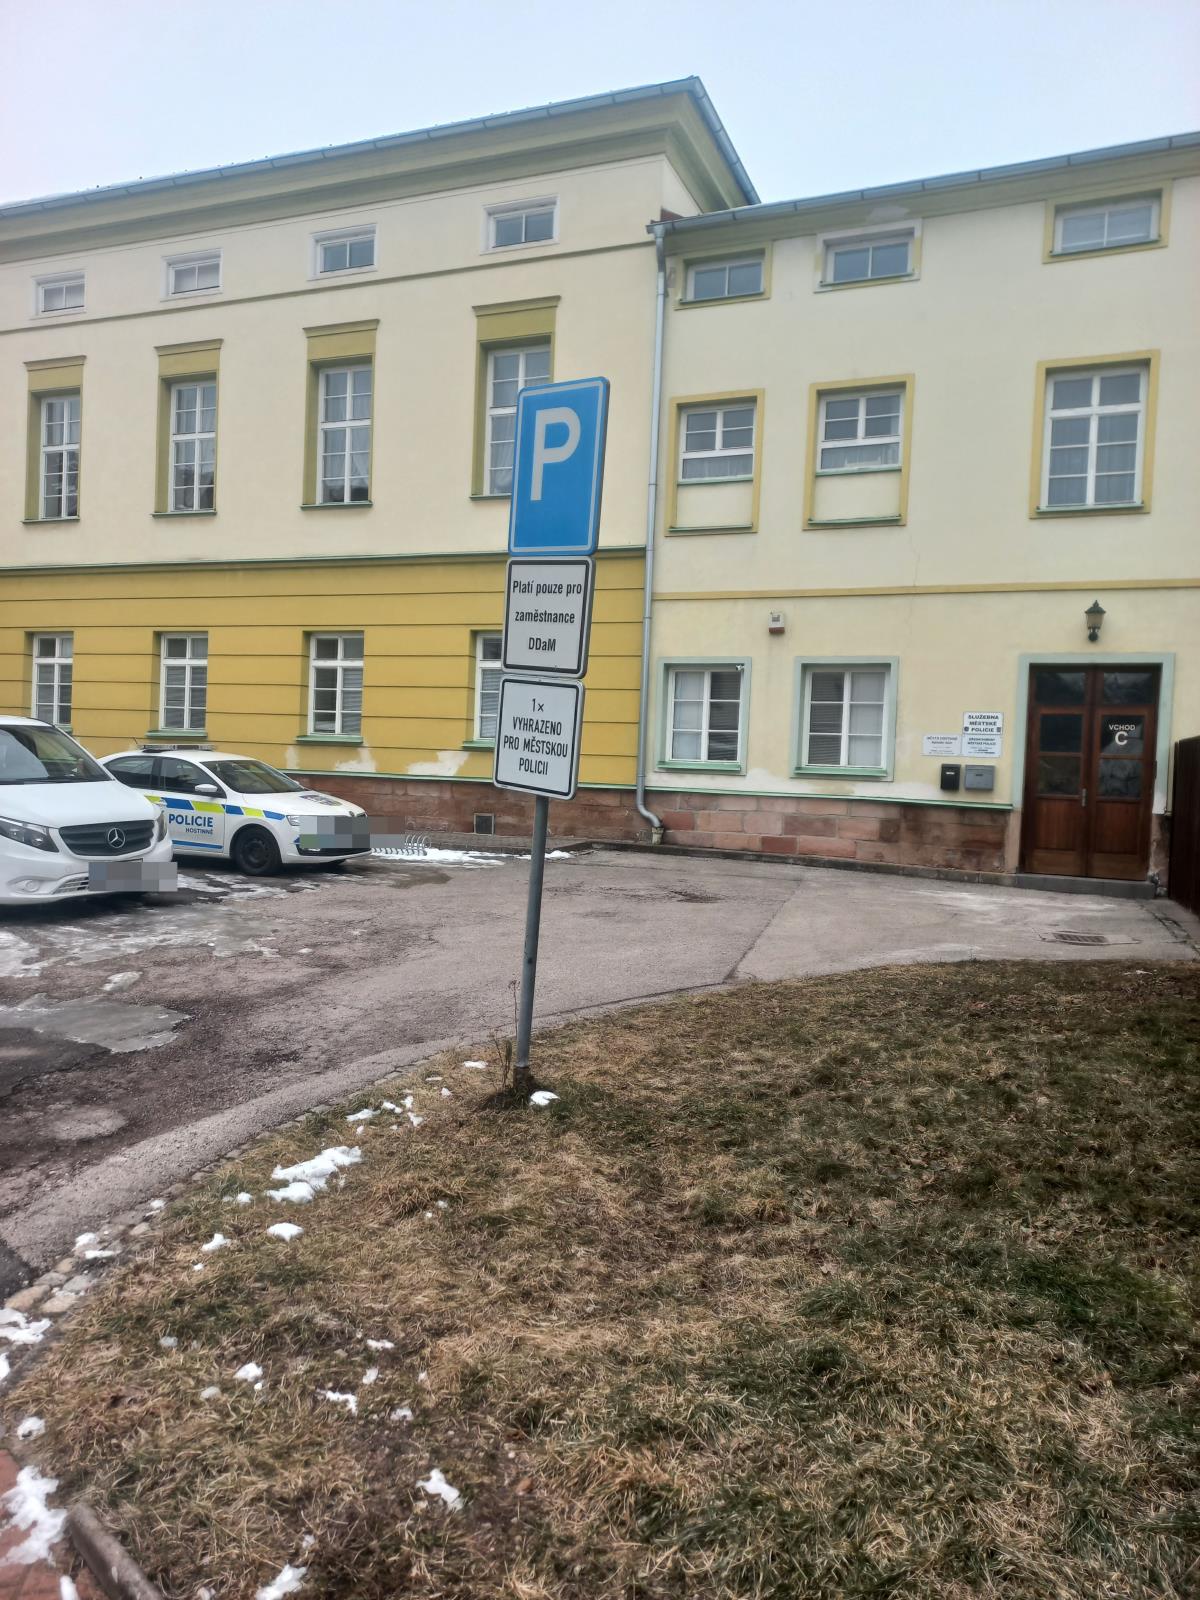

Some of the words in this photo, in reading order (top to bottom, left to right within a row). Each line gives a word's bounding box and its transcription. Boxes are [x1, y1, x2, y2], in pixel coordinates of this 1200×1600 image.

[530, 406, 581, 501] P
[512, 579, 534, 594] Platí
[536, 583, 563, 596] pouze
[566, 583, 582, 597] pro
[515, 609, 575, 623] zaměstnance
[528, 637, 556, 652] DDaM
[513, 716, 562, 736] VYHRAZENO
[503, 735, 519, 750] PRO
[523, 736, 568, 758] MĚSTSKOU
[1115, 731, 1128, 745] C
[518, 757, 549, 775] POLICII
[168, 813, 214, 828] POLICIE
